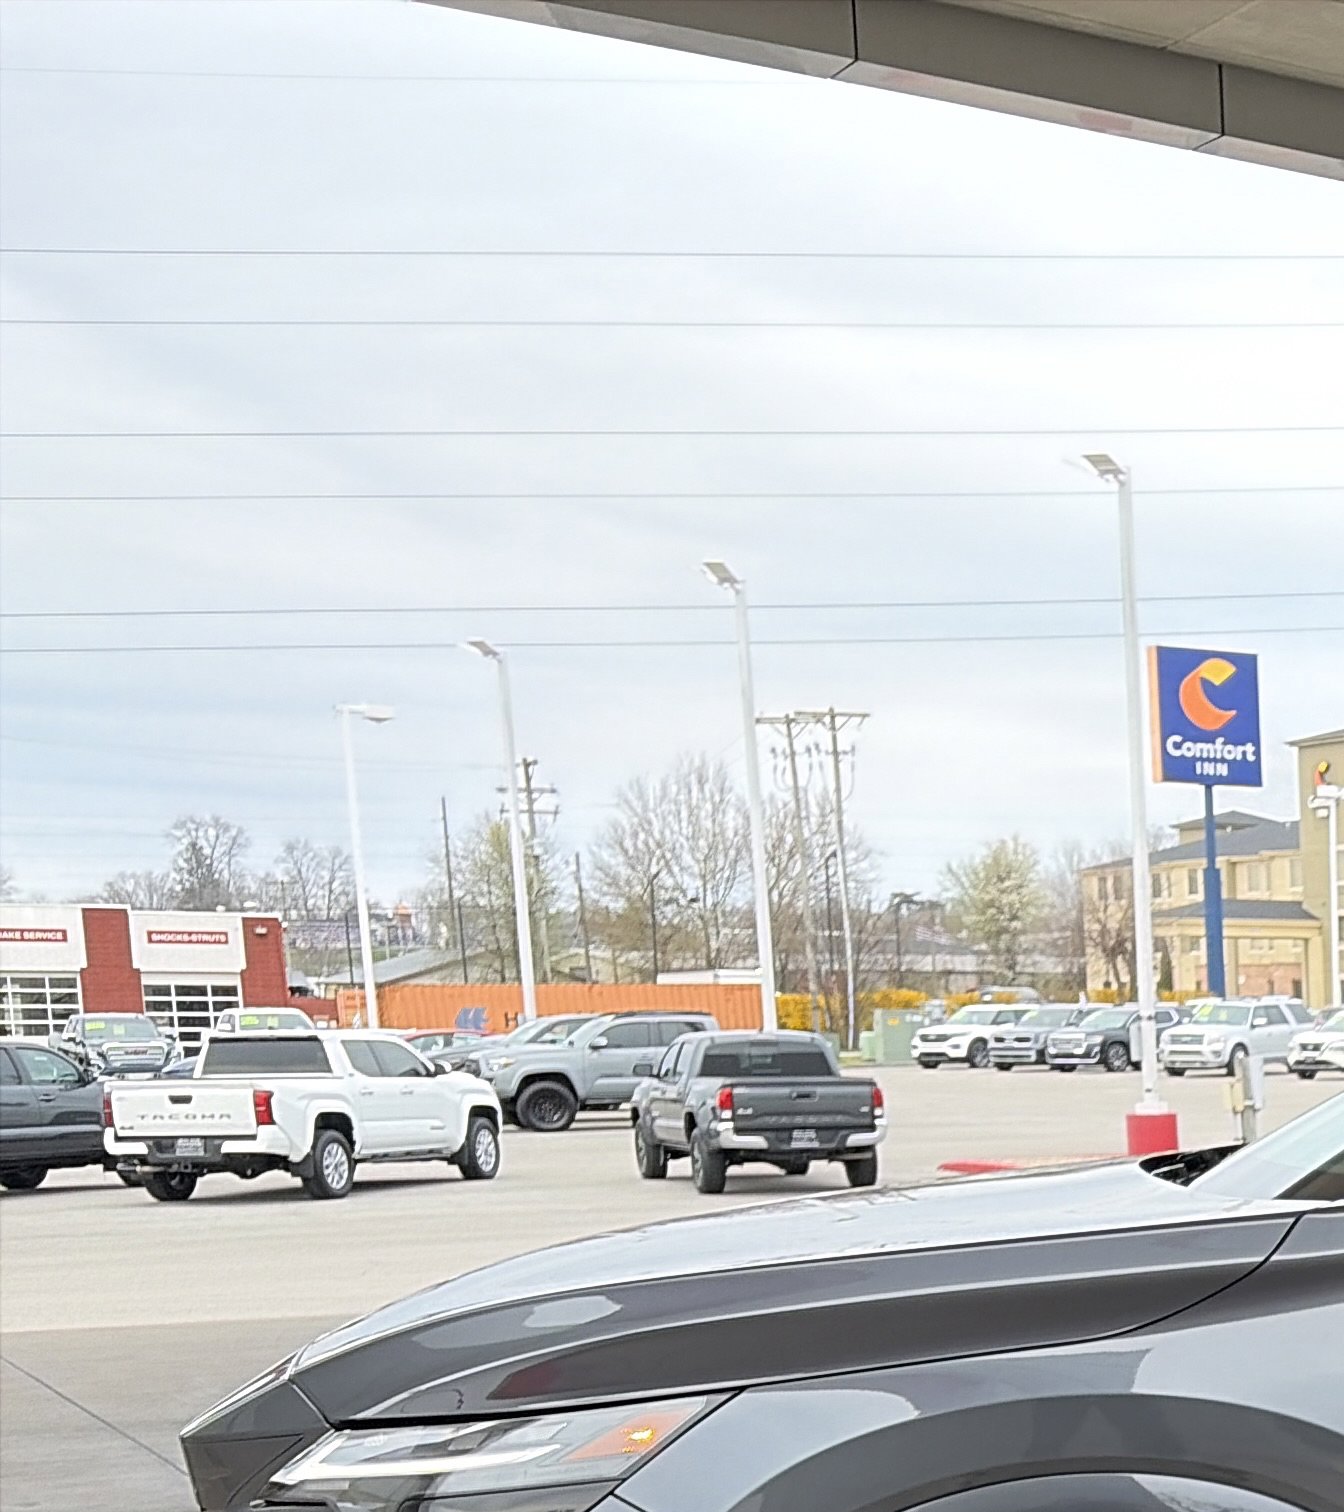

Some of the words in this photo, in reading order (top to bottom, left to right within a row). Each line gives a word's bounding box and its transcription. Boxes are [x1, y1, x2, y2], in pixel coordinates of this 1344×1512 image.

[1165, 734, 1256, 762] Comfort
[1195, 760, 1229, 777] INN
[22, 930, 64, 940] SERVICE
[136, 1112, 232, 1121] TACOMA
